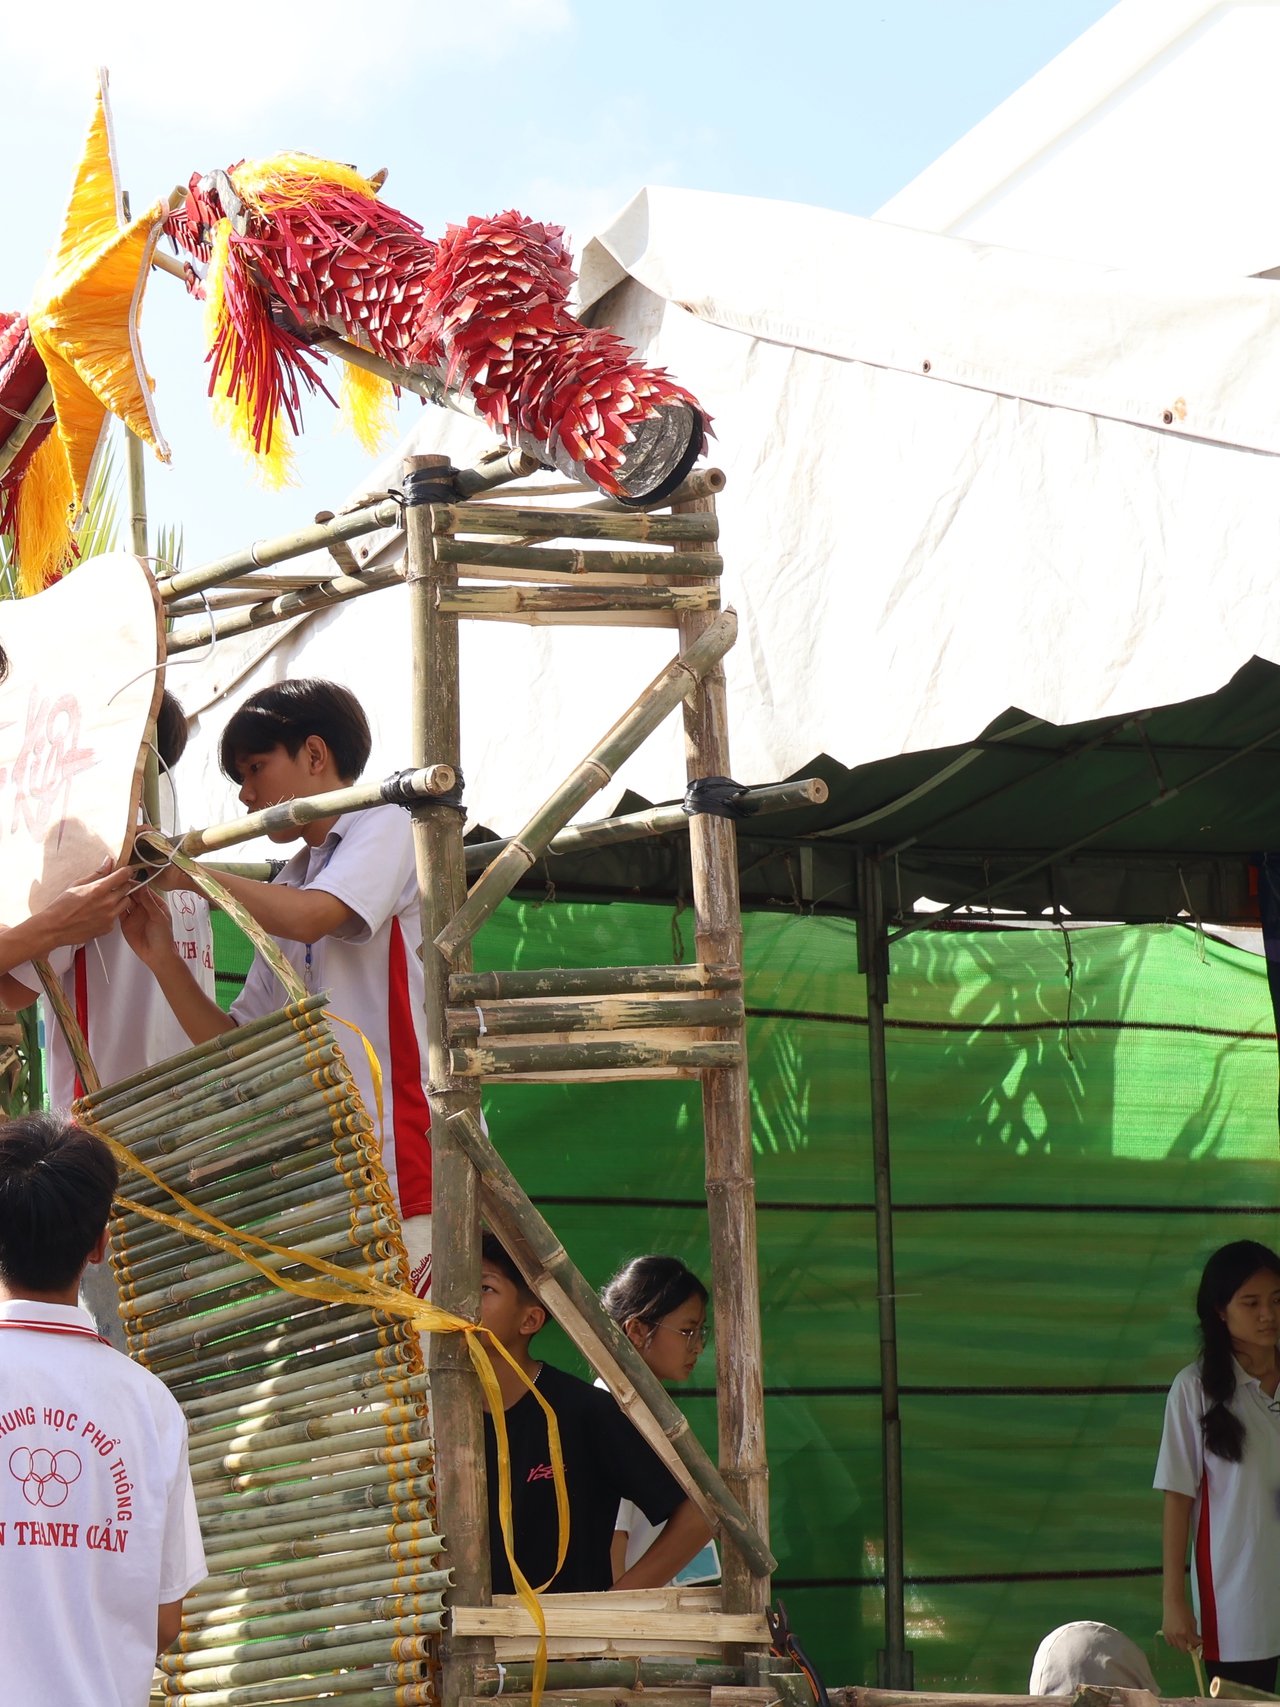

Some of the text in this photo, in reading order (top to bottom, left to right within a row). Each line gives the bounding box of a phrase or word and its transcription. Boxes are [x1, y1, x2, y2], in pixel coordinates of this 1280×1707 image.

[43, 1407, 78, 1433] HỌC
[81, 1421, 121, 1457] PHỔ
[109, 1457, 133, 1522] THÔNG
[14, 1521, 79, 1550] THANH
